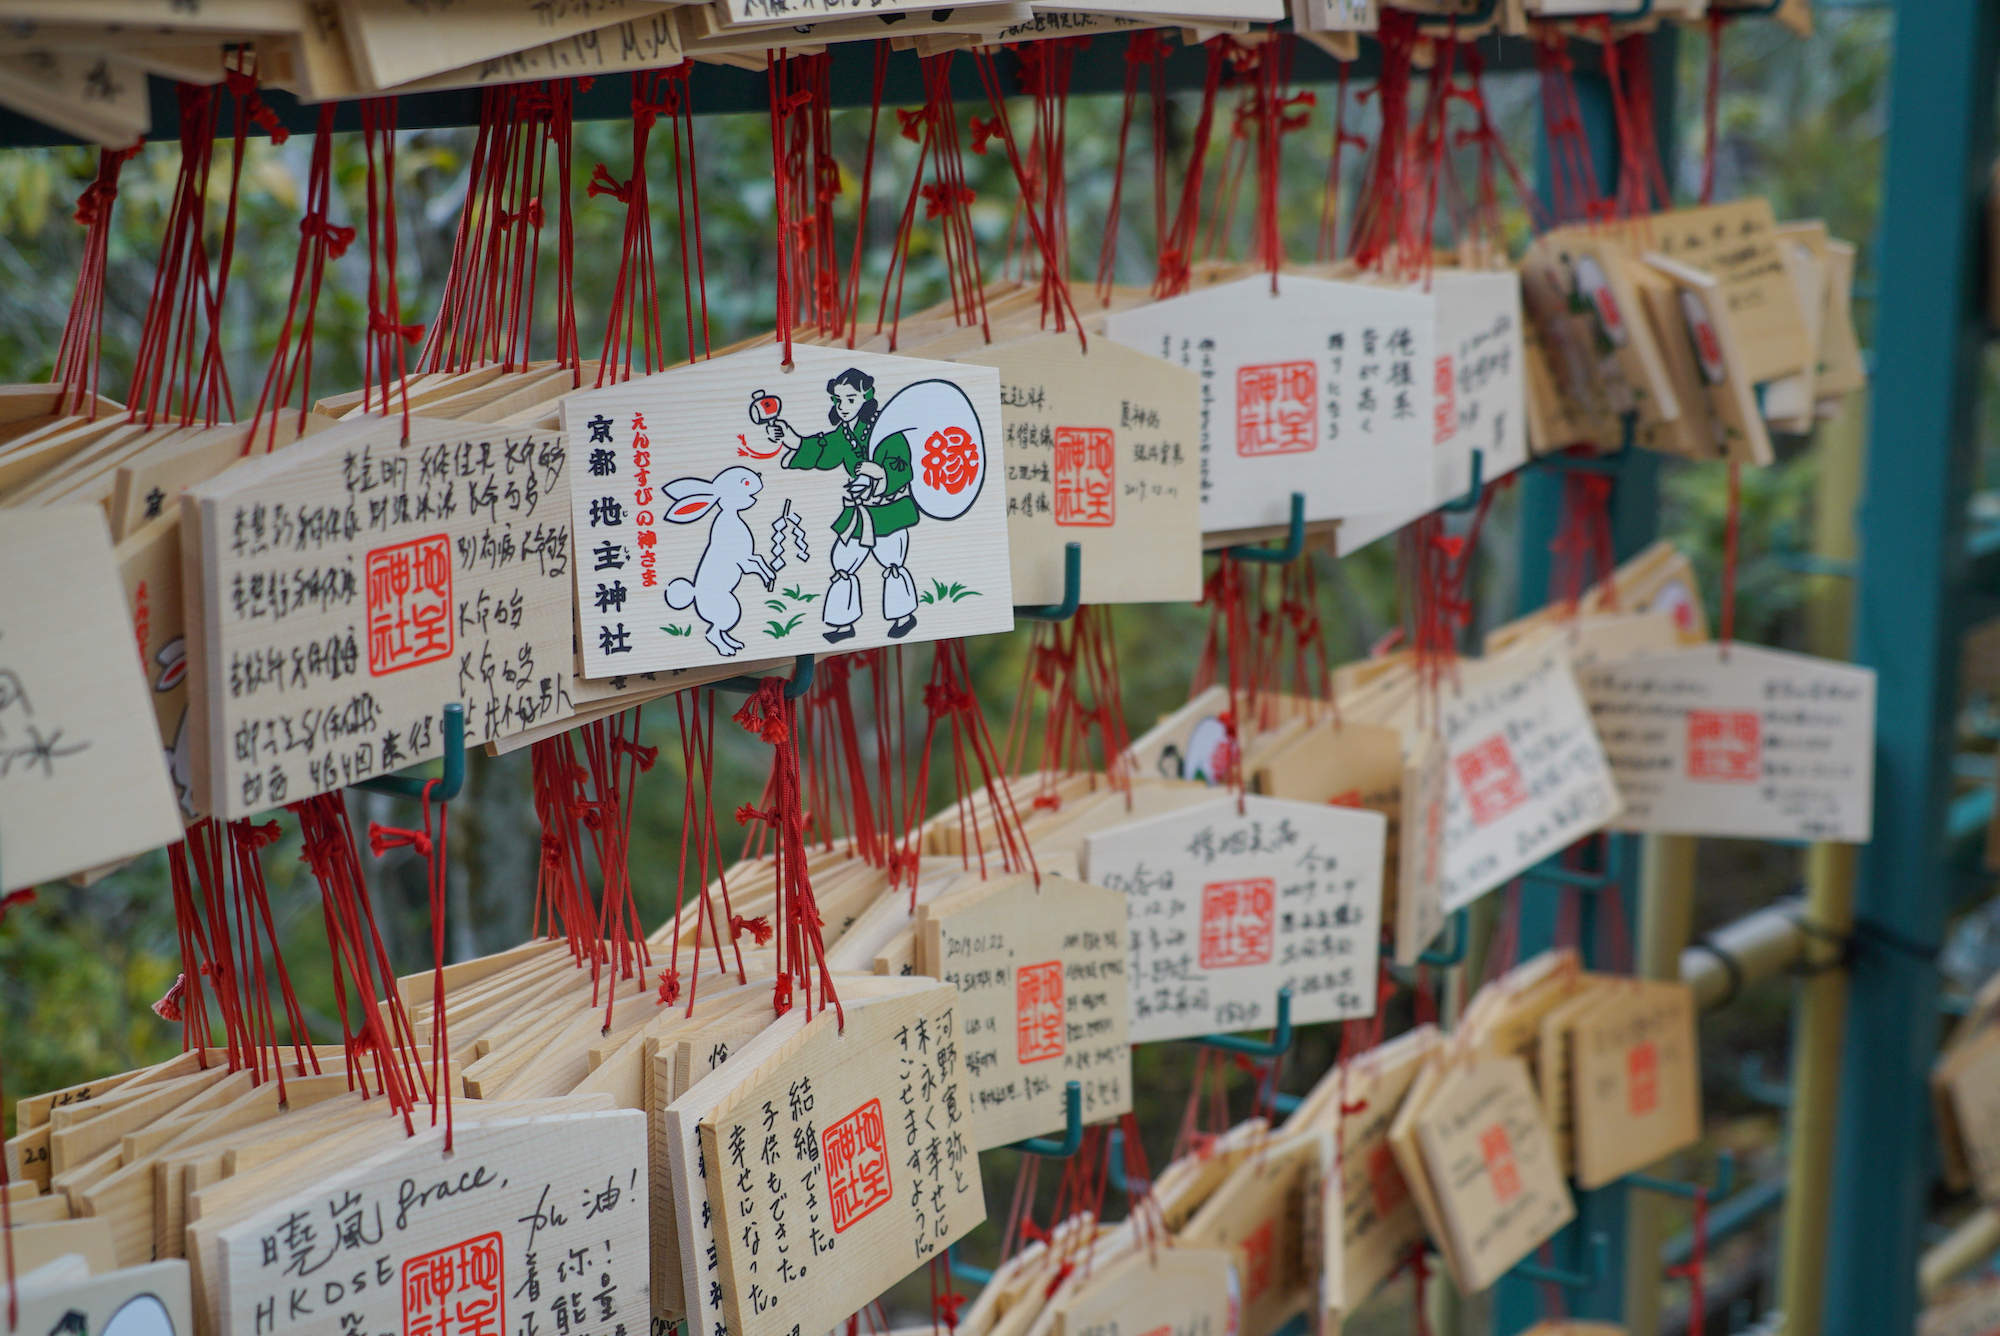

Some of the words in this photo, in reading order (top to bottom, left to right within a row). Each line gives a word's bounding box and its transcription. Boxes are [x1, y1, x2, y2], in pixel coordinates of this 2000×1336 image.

[587, 414, 633, 656] 京都地主神社
[632, 412, 658, 587] えんむすびの神さま
[920, 426, 980, 495] 縁
[728, 1124, 778, 1316] 幸せになった。
